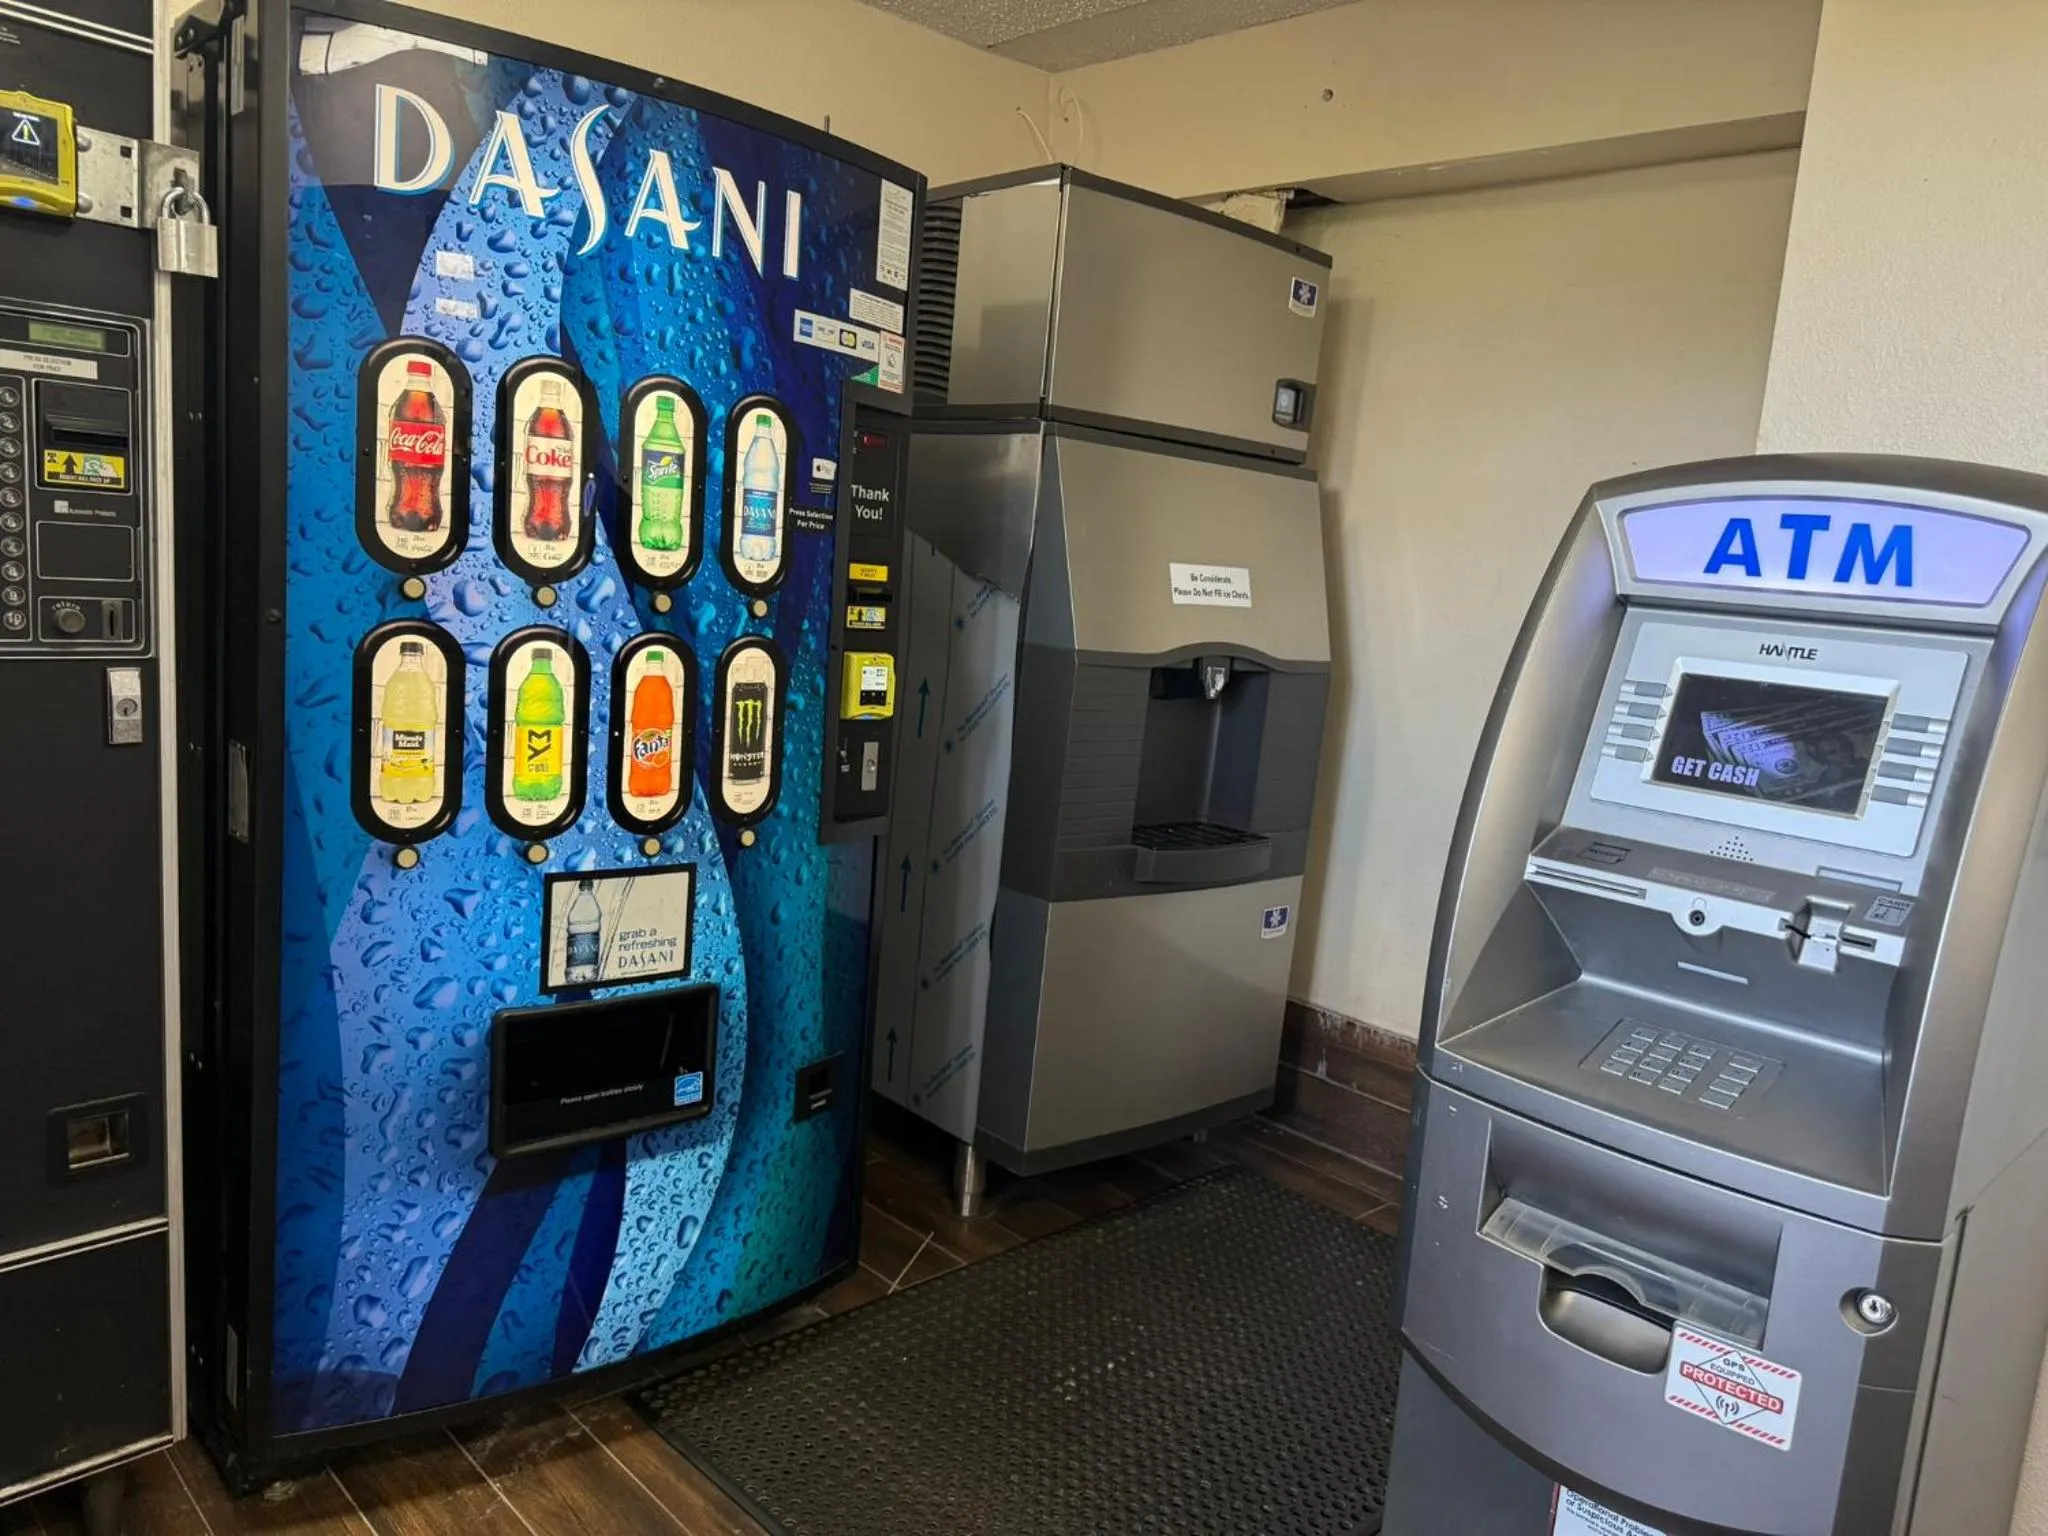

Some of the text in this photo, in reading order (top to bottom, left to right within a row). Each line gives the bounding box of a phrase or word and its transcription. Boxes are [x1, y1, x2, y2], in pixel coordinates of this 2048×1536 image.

[374, 83, 803, 281] DASANI
[526, 445, 571, 468] Coke
[851, 484, 890, 502] Thank
[855, 504, 883, 521] You!
[1704, 513, 1913, 587] ATM
[1193, 587, 1201, 597] Do
[1671, 755, 1760, 787] GET CASH
[619, 928, 657, 941] grab a
[618, 937, 678, 952] refreshing
[618, 950, 674, 969] DASANI
[1710, 1362, 1756, 1386] EQUIPPED
[1722, 1357, 1746, 1372] GPS
[1682, 1363, 1780, 1411] PROTECTED
